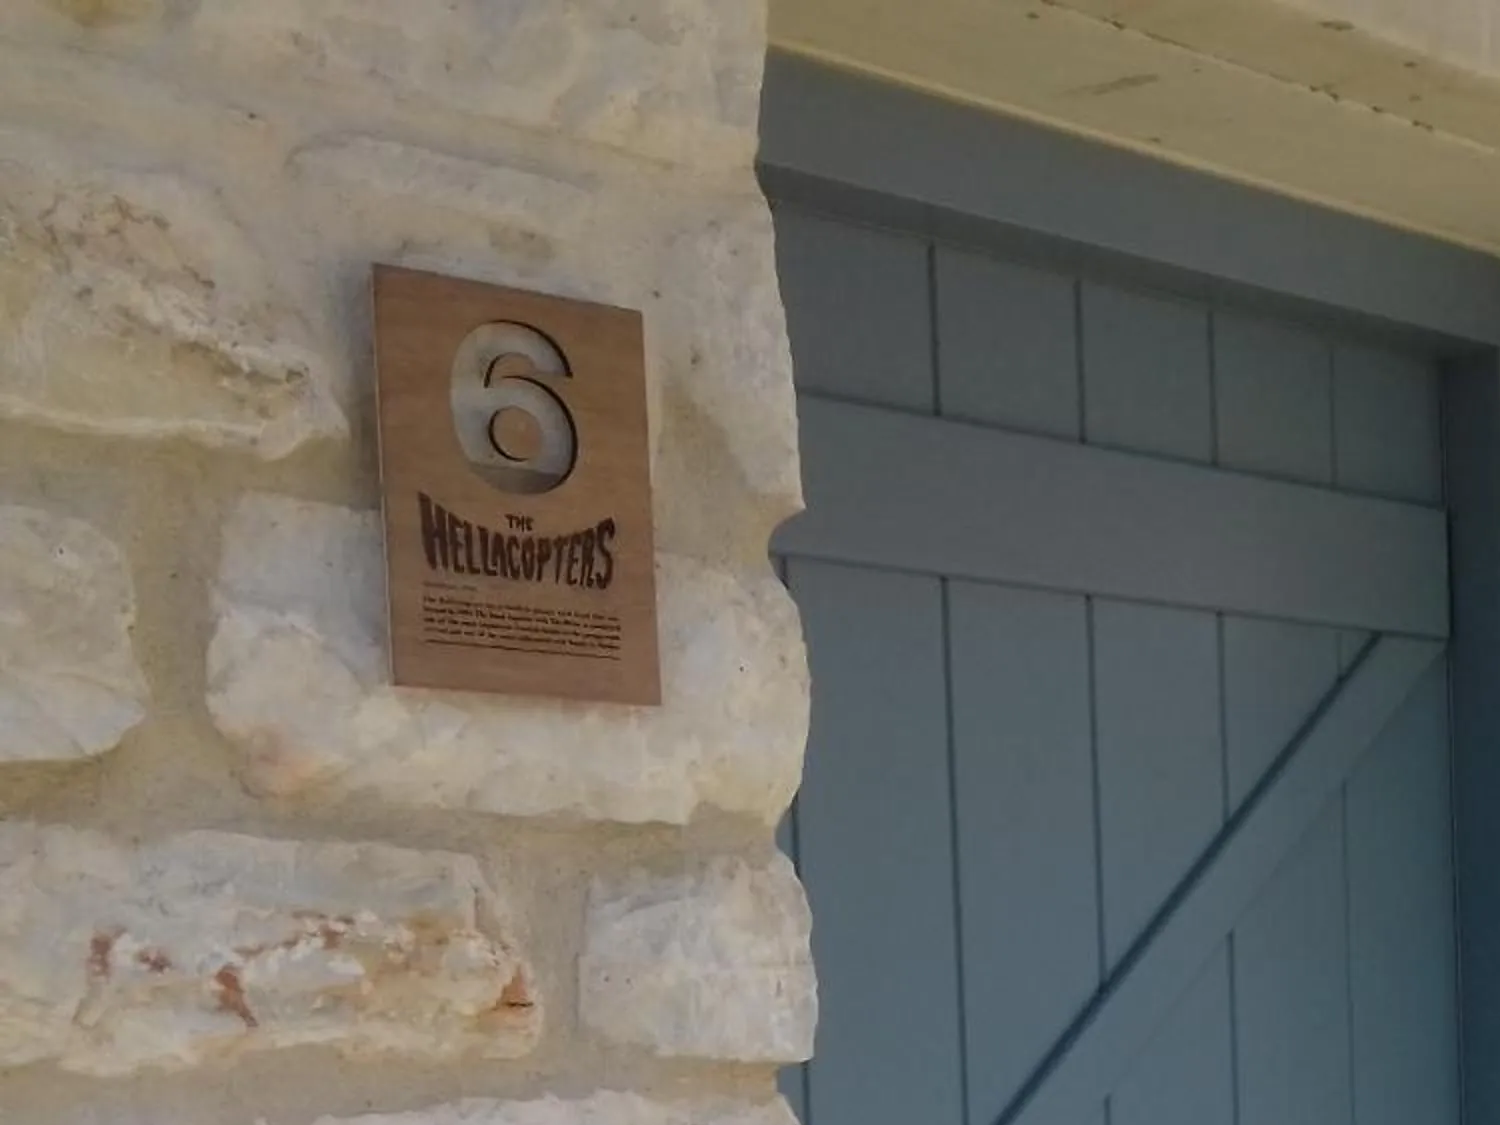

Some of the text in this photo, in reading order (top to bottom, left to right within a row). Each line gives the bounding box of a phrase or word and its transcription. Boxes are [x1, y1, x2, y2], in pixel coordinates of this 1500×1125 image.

[451, 319, 578, 494] 6
[418, 492, 616, 590] HELLACOPTERS
[506, 514, 534, 531] THE
